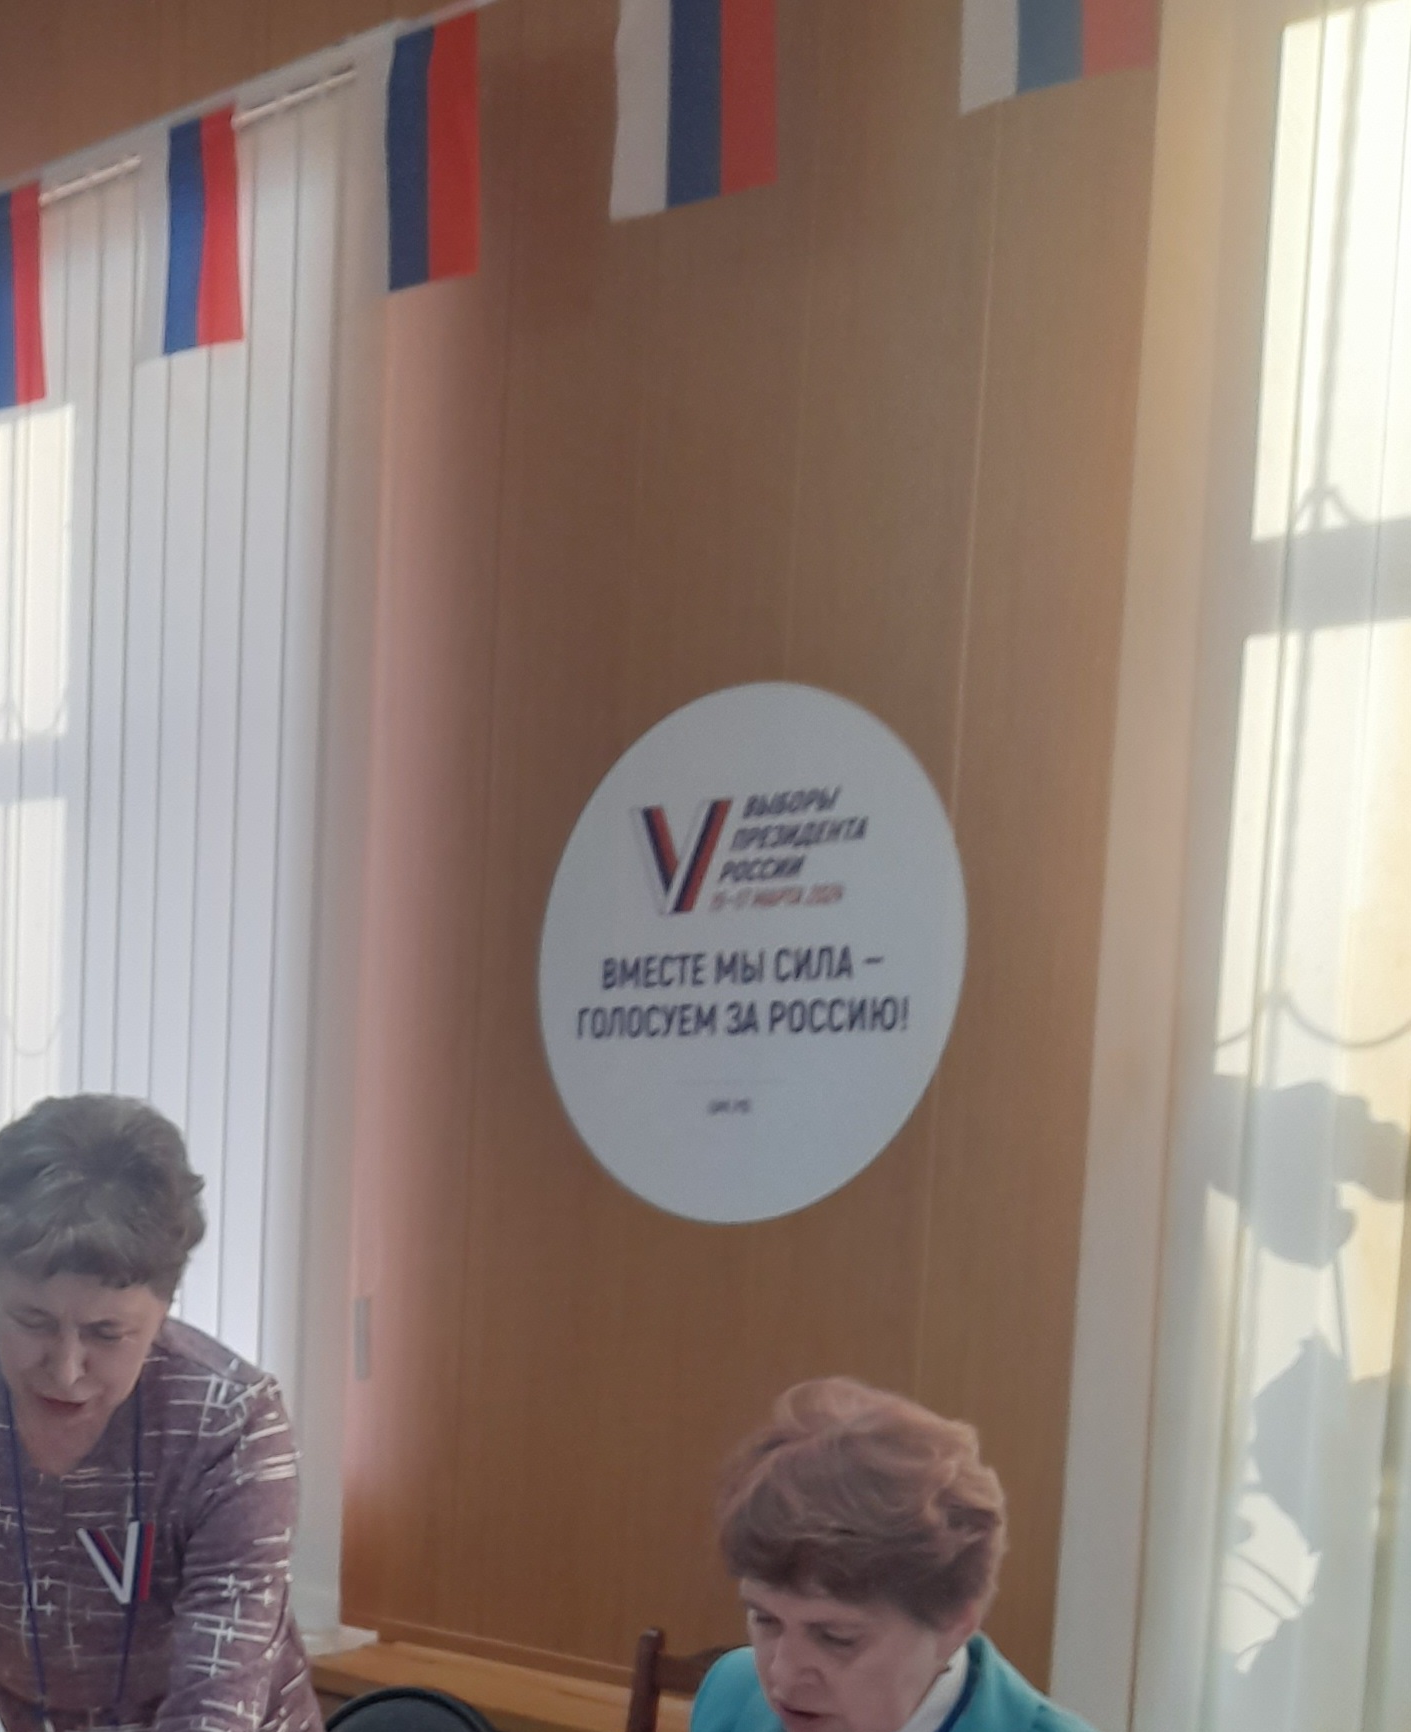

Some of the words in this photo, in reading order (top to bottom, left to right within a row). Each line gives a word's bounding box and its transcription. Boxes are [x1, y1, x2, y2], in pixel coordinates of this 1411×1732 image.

[742, 786, 840, 820] ВЫБОРЫ
[730, 816, 868, 850] ПРЕЗИДЕНТА
[719, 855, 806, 884] РОССИИ
[601, 953, 705, 990] ВМЕСТЕ
[714, 950, 764, 985] МЫ
[774, 945, 854, 983] СИЛА
[577, 1004, 717, 1039] ГОЛОСУЕМ
[726, 1001, 759, 1035] ЗА
[768, 996, 910, 1034] РОССИЮ!
